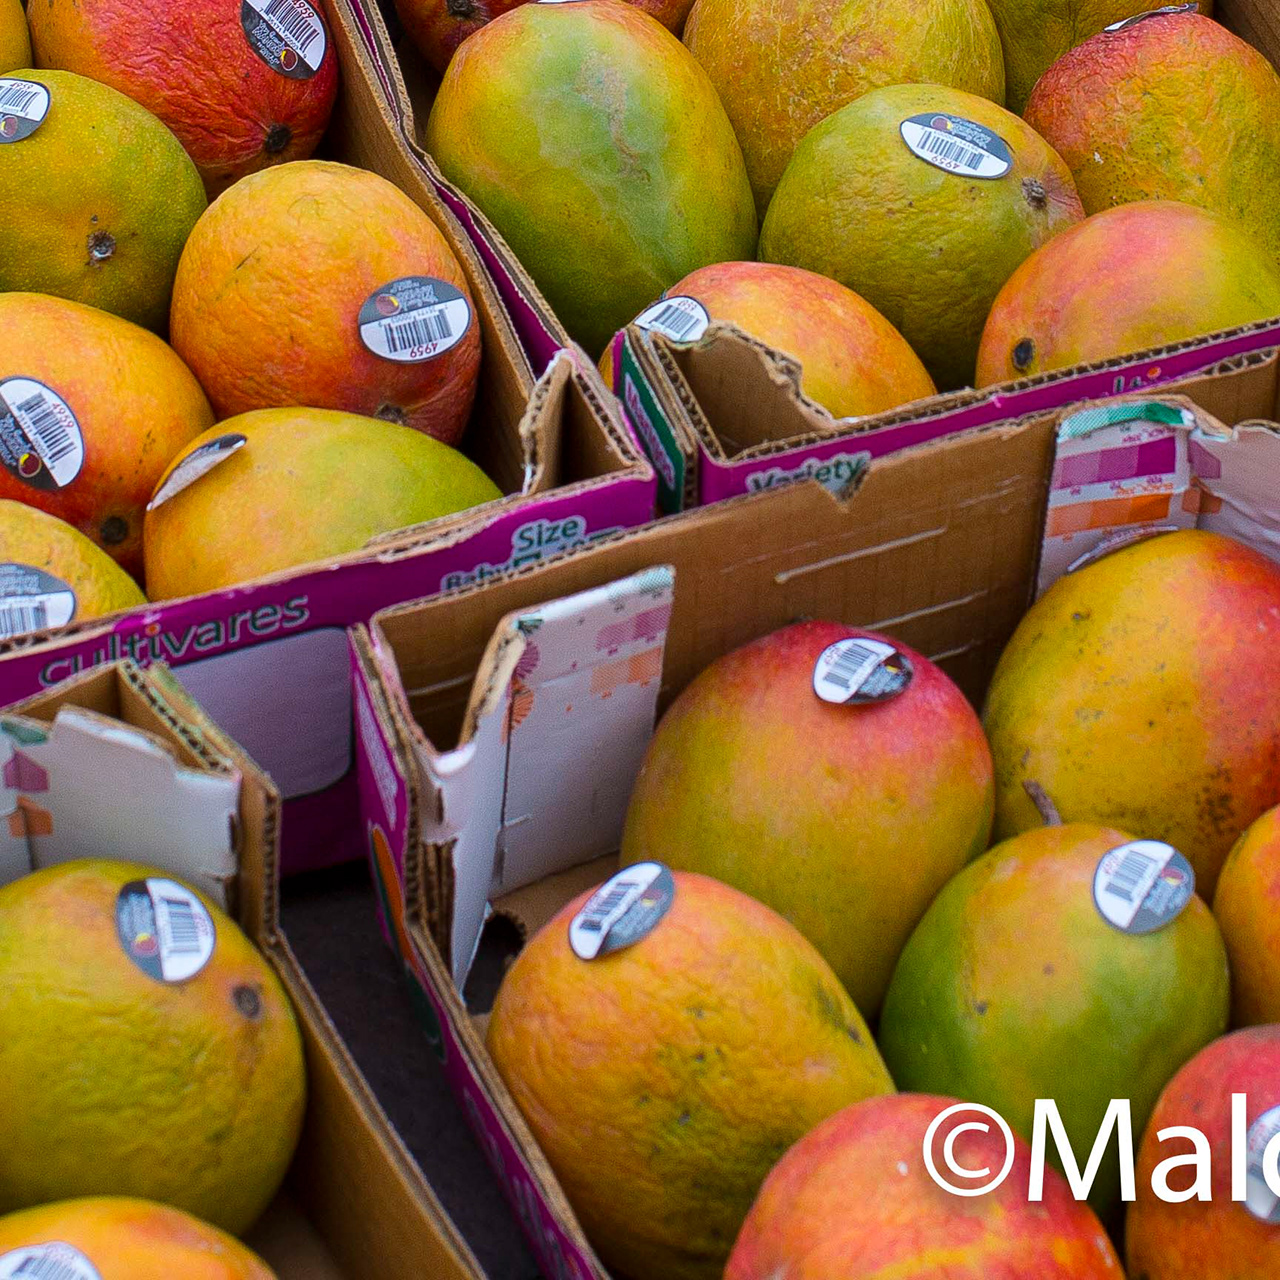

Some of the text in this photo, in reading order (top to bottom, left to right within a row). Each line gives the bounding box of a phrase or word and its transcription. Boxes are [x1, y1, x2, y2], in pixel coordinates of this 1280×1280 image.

[10, 80, 34, 91] 4959
[931, 155, 960, 169] 4959
[409, 342, 438, 358] 4959
[51, 402, 74, 429] 4959
[518, 519, 580, 550] Size
